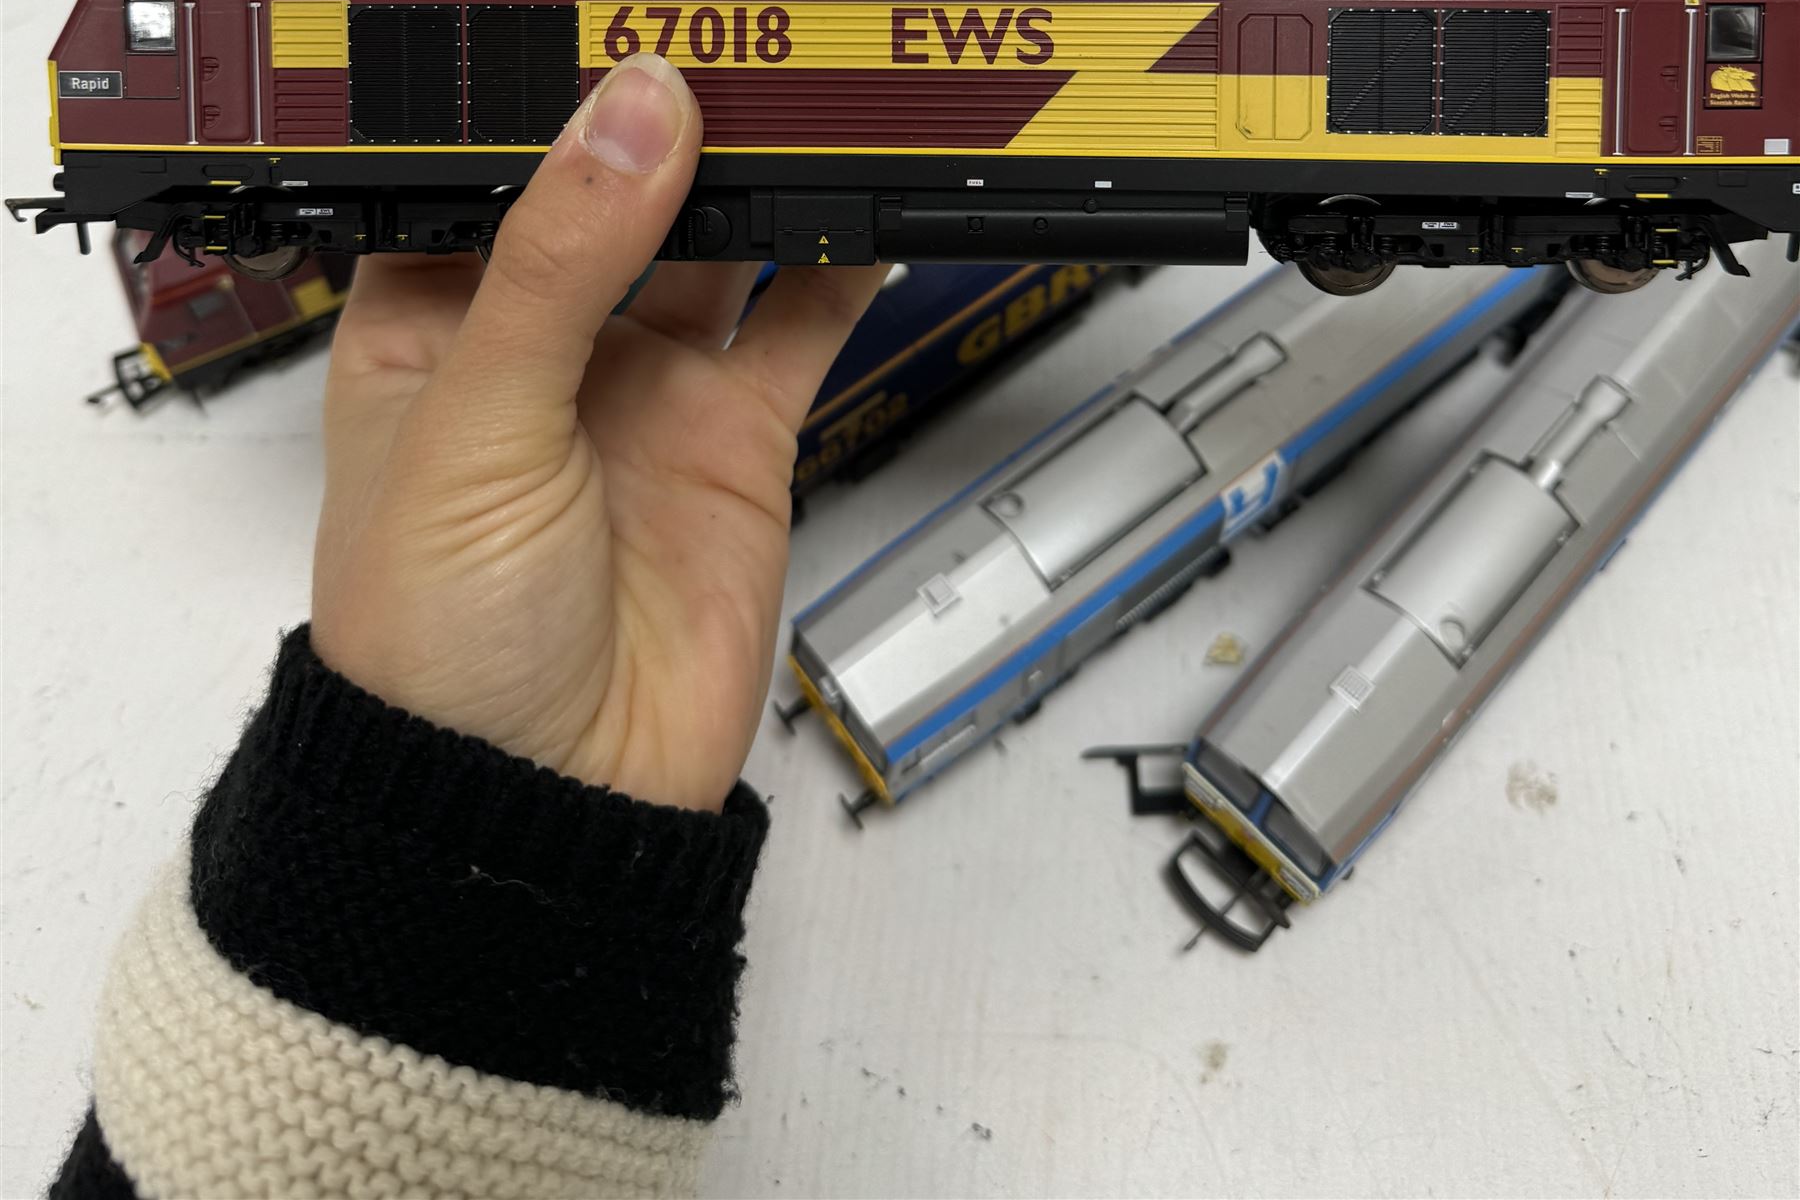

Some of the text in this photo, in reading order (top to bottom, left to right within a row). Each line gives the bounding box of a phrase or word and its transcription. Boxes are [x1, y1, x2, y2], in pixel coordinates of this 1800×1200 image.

[604, 6, 792, 64] 67018
[891, 7, 1055, 65] EWS
[71, 77, 110, 92] Rapid
